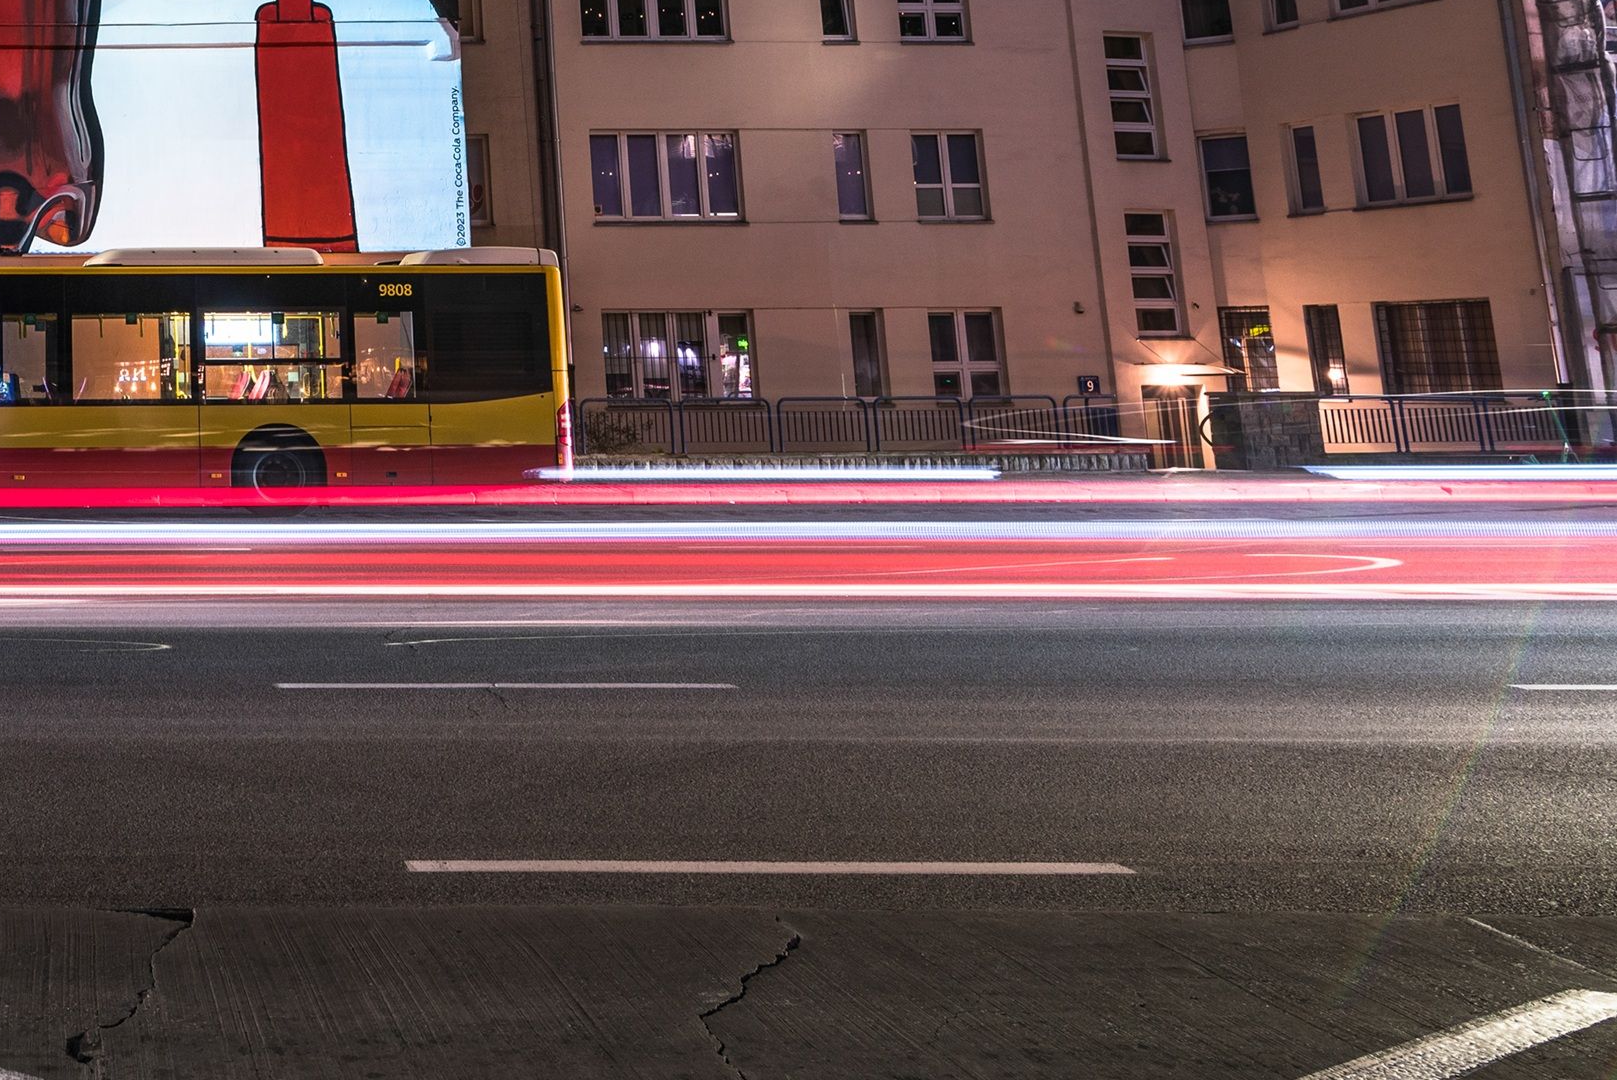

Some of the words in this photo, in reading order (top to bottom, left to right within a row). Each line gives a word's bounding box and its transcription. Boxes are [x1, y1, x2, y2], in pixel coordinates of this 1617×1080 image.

[451, 86, 460, 135] Company.
[452, 138, 463, 187] Coca-Cola
[455, 189, 464, 210] The
[378, 283, 413, 297] 9808
[1086, 379, 1094, 392] 9
